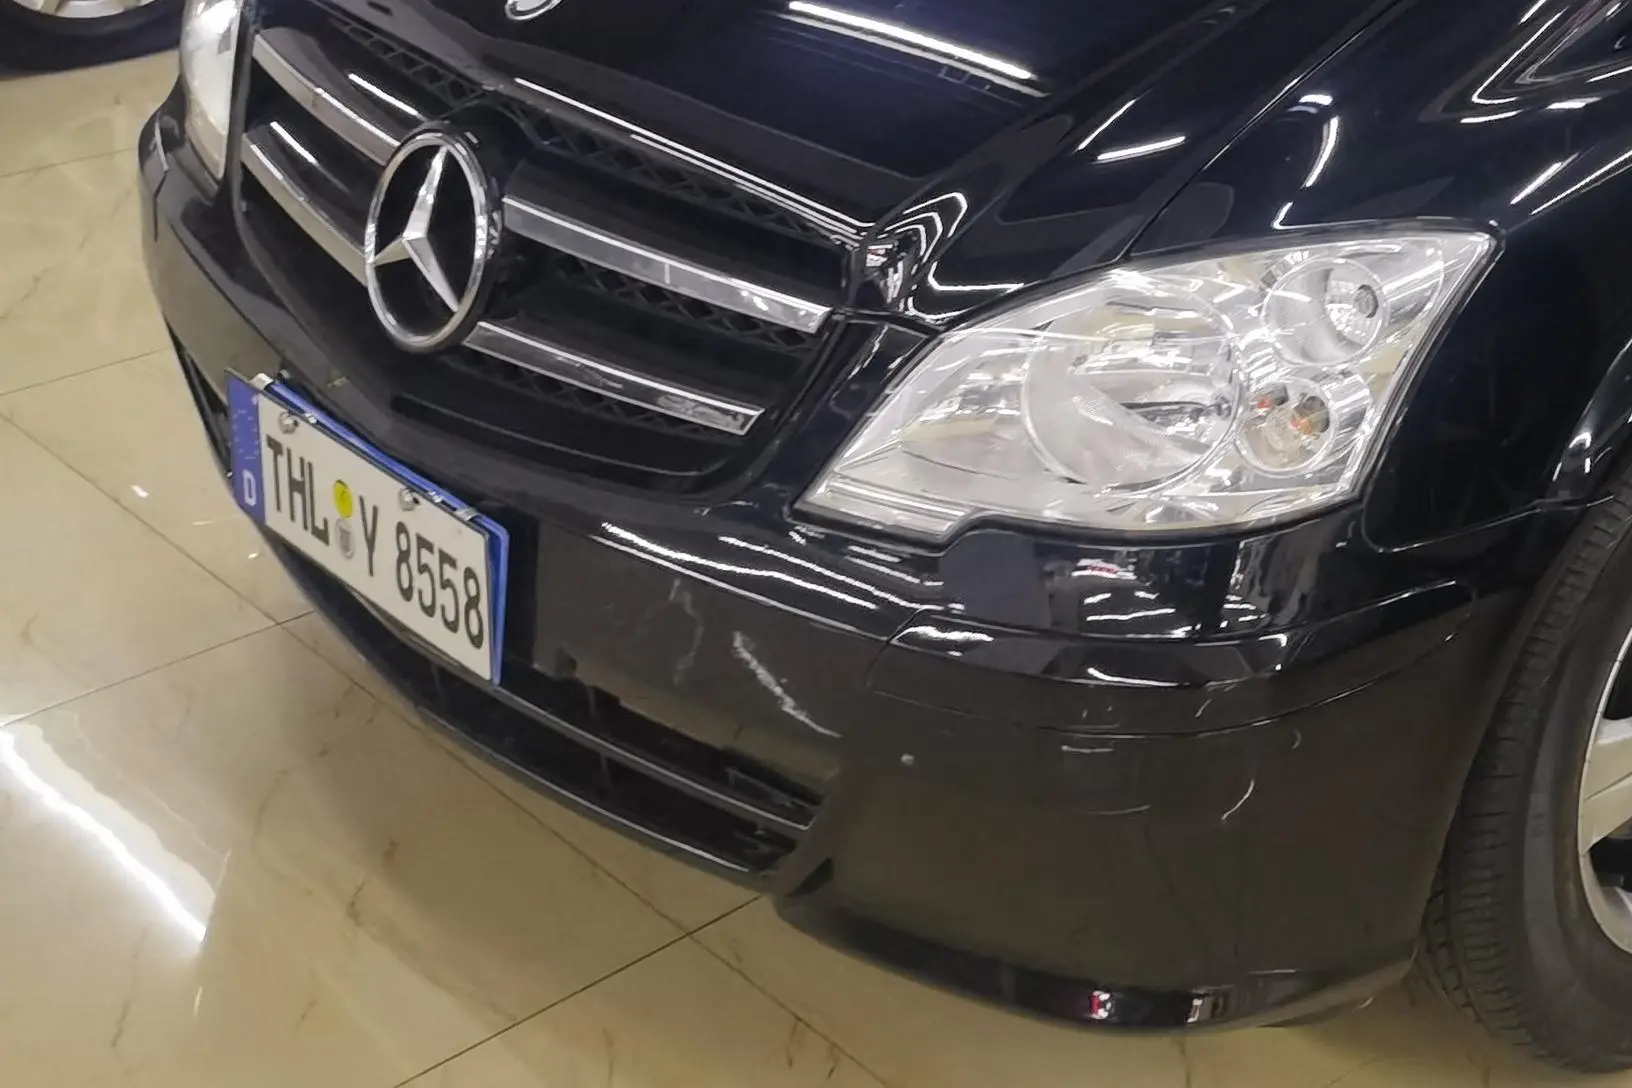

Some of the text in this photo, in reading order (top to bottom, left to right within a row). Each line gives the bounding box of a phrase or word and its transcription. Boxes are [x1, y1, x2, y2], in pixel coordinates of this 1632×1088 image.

[242, 469, 258, 507] D
[266, 434, 484, 650] THL Y 8558
